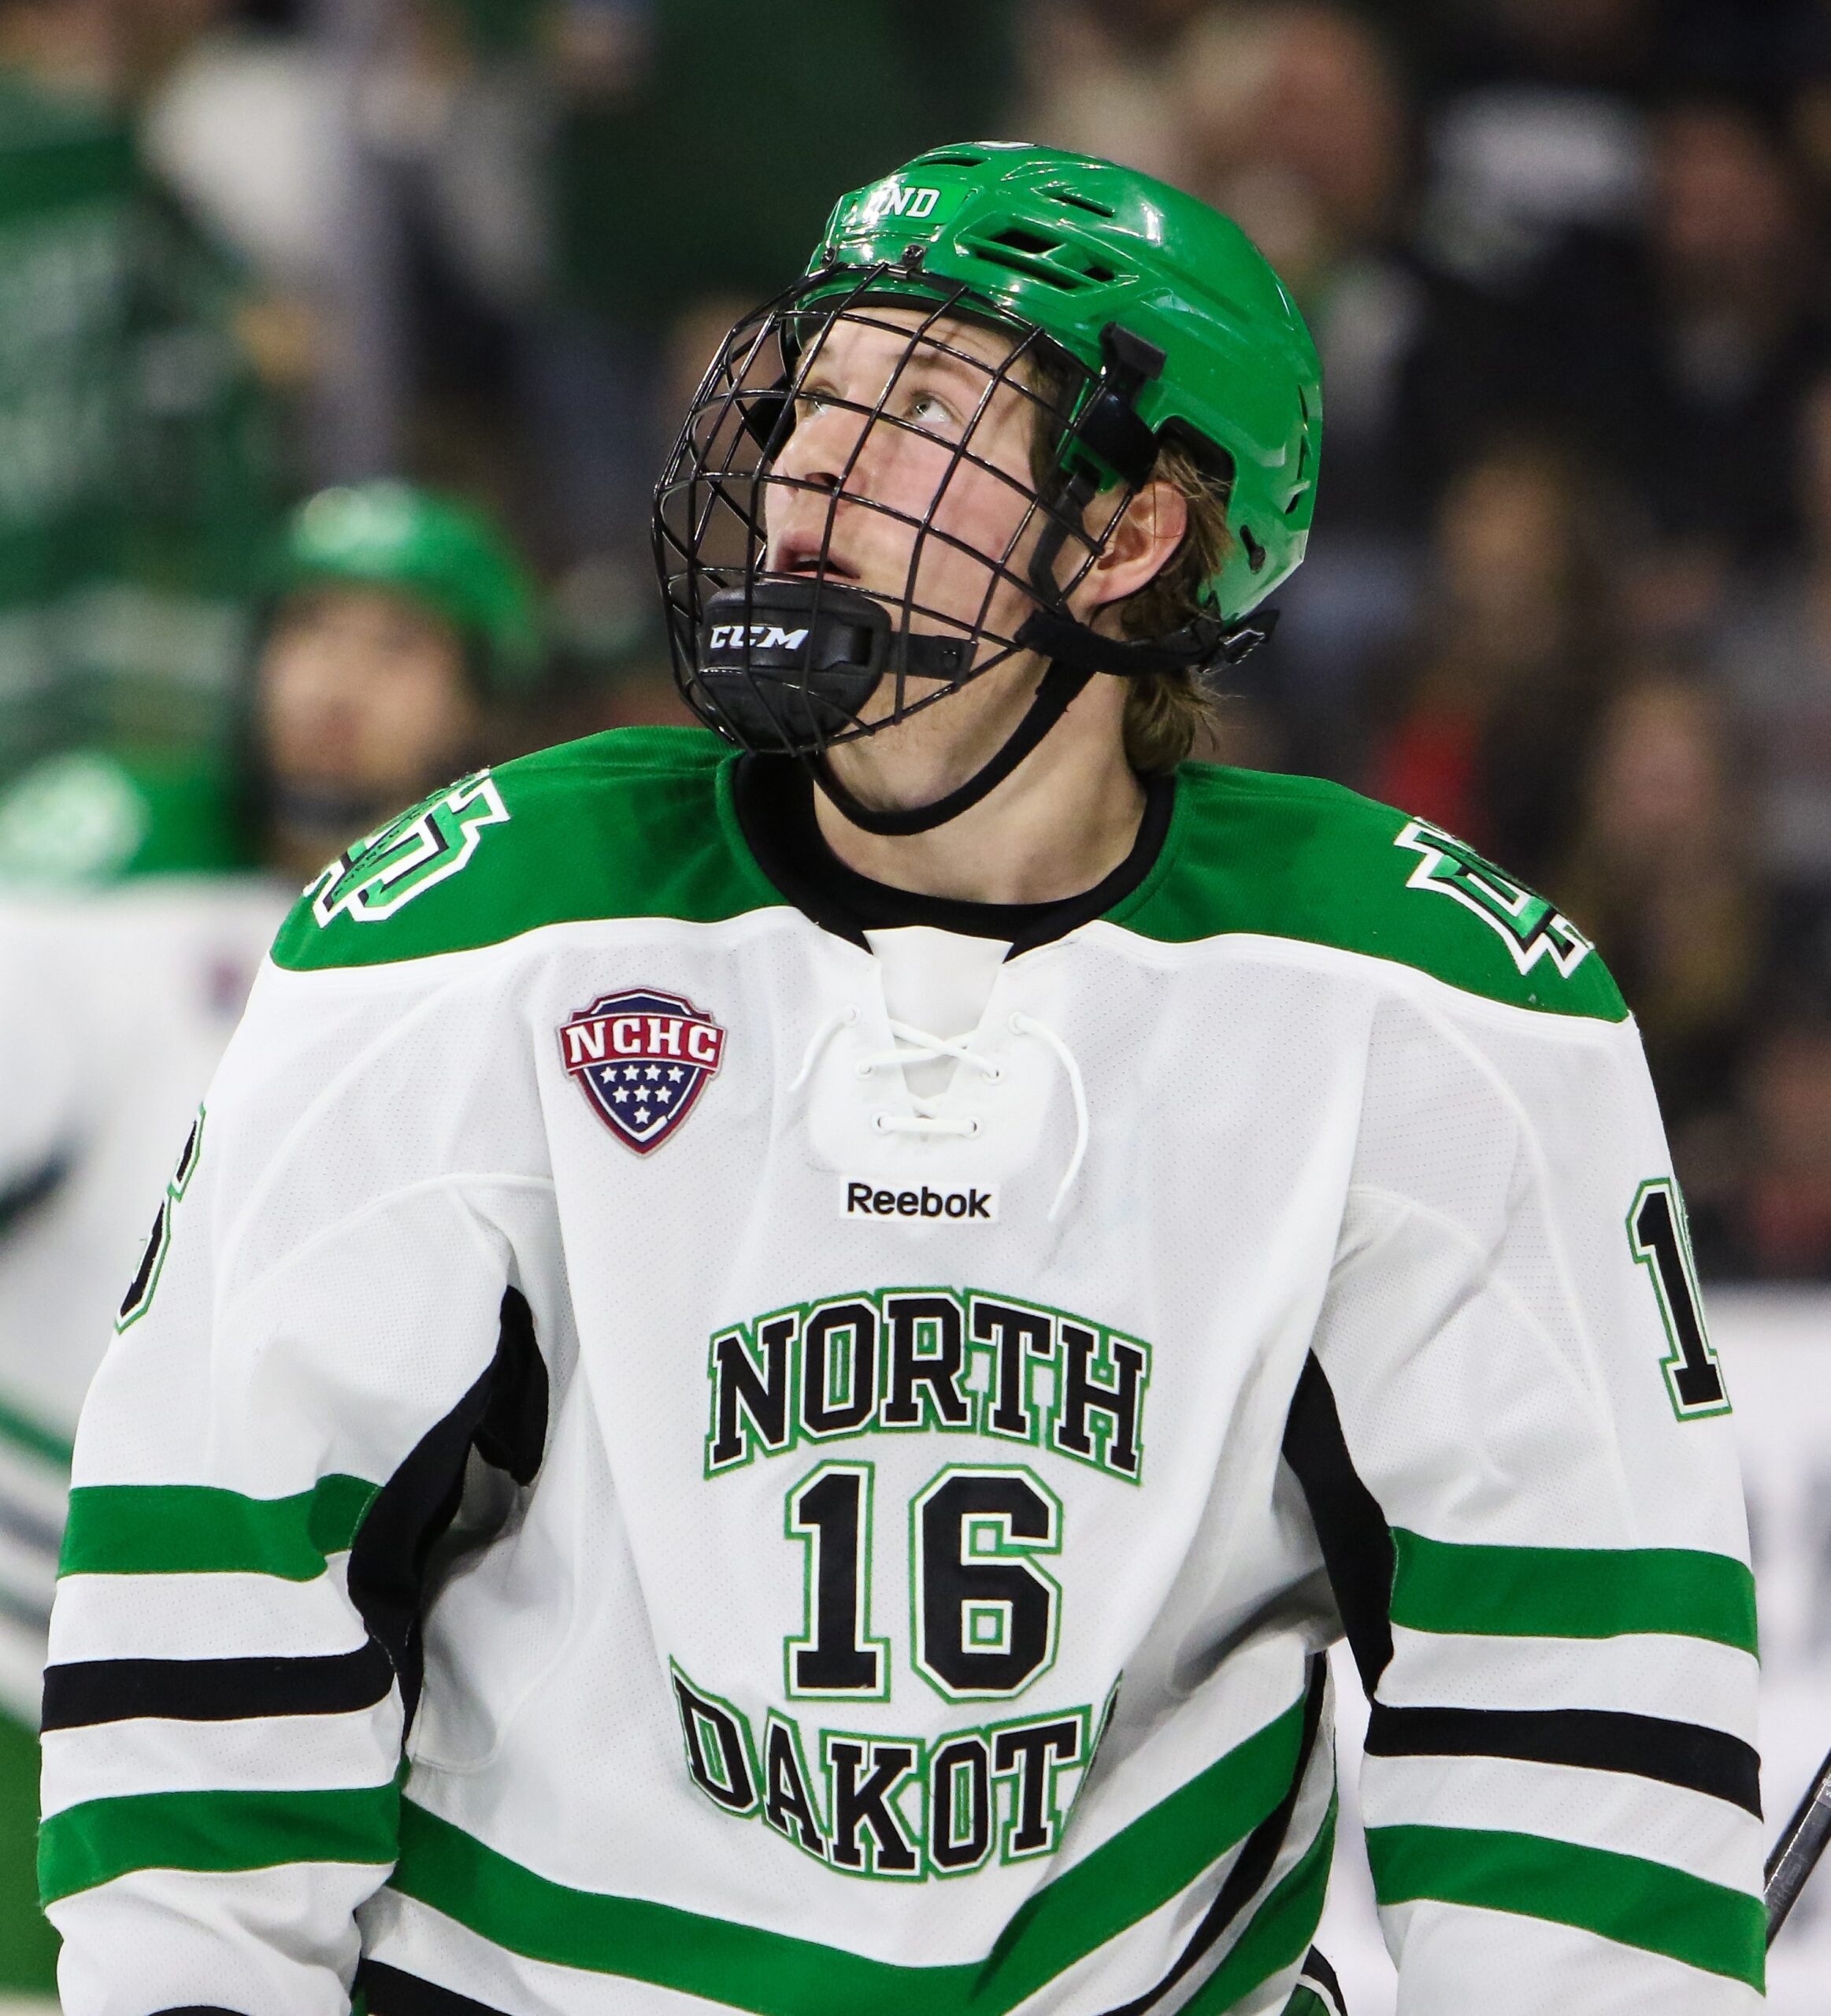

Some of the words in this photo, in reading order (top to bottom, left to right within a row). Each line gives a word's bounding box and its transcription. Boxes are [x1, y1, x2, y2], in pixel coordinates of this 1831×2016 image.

[710, 625, 810, 649] CCM
[566, 1017, 717, 1064] NCHC
[847, 1183, 991, 1218] Reebok
[703, 1286, 1152, 1487] NORTH
[784, 1459, 1064, 1703] 16
[669, 1654, 1123, 1883] DAKOT
